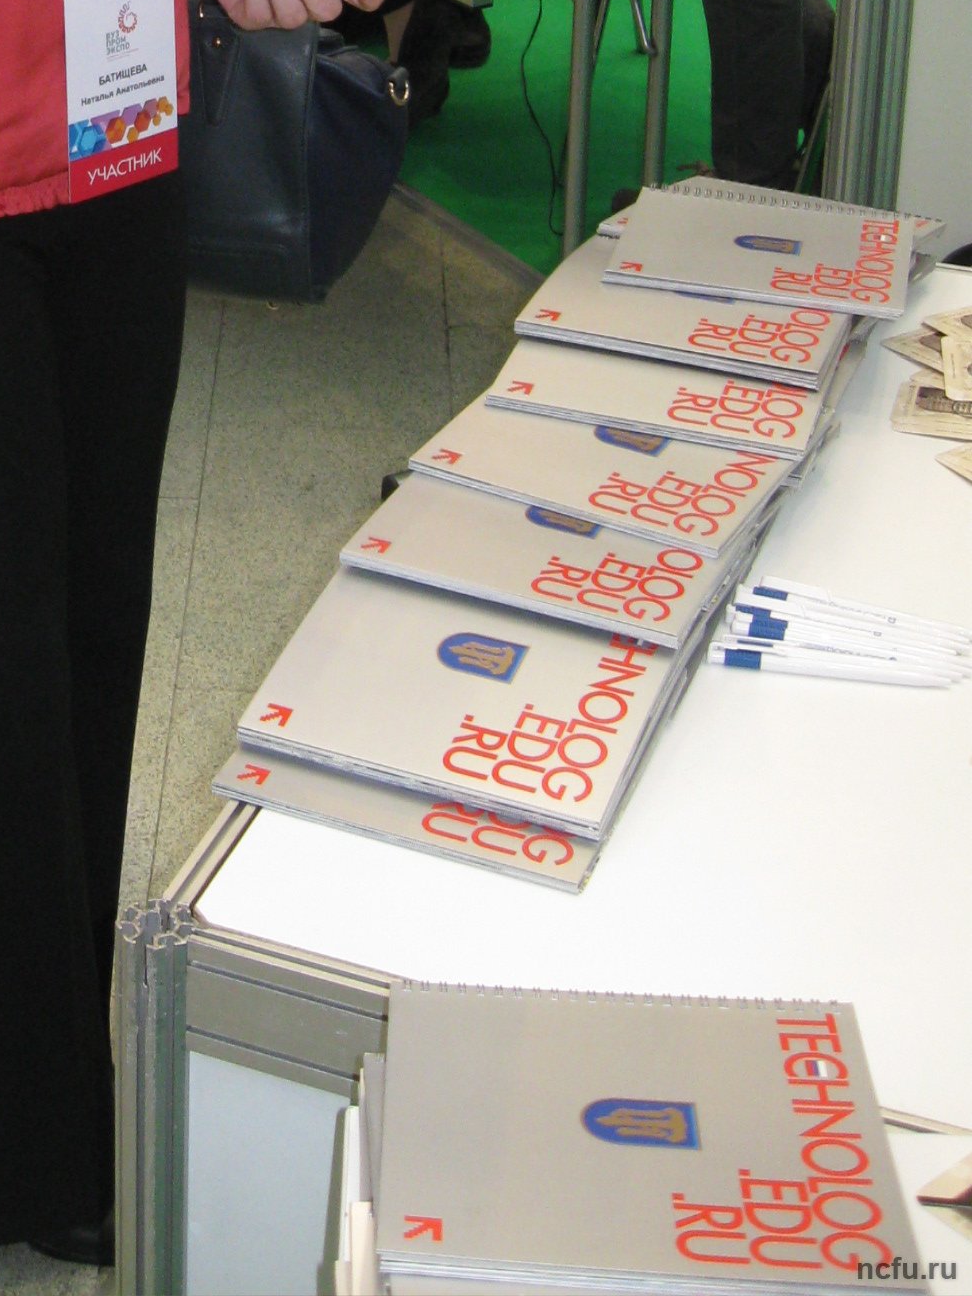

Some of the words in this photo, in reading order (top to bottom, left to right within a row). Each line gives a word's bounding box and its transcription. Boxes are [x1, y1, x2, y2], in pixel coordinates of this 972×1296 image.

[106, 42, 130, 55] ЭКСПО
[81, 90, 114, 106] Наталья
[116, 75, 165, 96] Анатольевна
[98, 63, 147, 86] БАТИЩЕВА
[87, 147, 162, 186] УЧАСТНИК
[770, 267, 813, 294] .RU
[810, 263, 853, 300] .EDU
[688, 318, 737, 351] .RU
[729, 314, 784, 358] .EDU
[770, 305, 831, 363] OLOG
[667, 387, 718, 426] .RU
[710, 380, 765, 433] .EDU
[588, 472, 648, 515] .RU
[630, 471, 702, 527] .EDU
[530, 556, 593, 602] .RU
[577, 552, 647, 613] .EDU
[442, 714, 509, 781] .RU
[491, 703, 567, 793] .EDU
[776, 1013, 894, 1272] TECHNOLOG
[671, 1192, 752, 1267] .RU
[738, 1169, 824, 1270] .EDU
